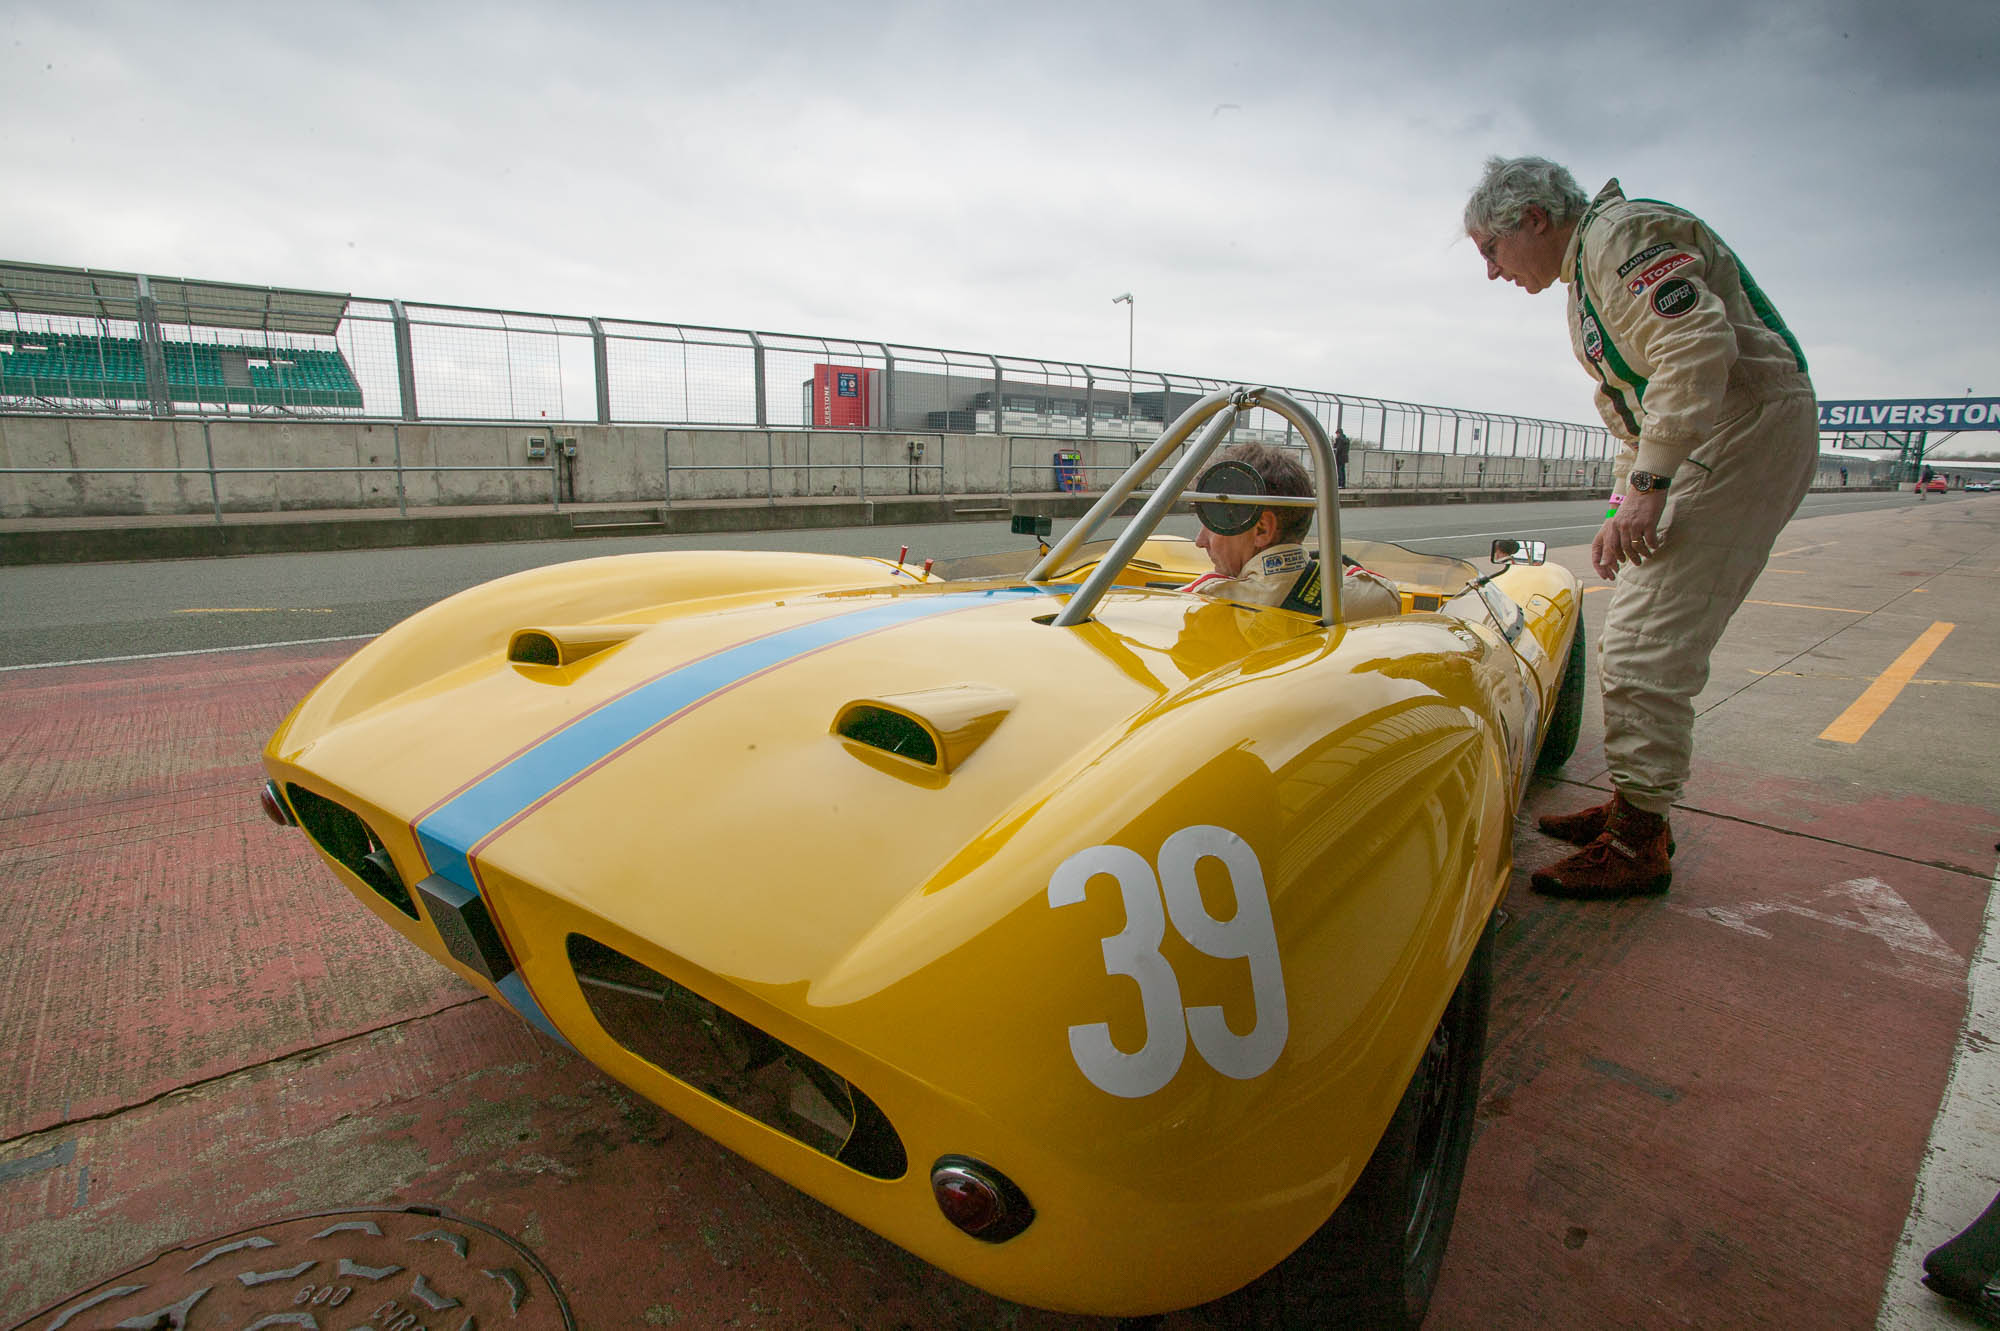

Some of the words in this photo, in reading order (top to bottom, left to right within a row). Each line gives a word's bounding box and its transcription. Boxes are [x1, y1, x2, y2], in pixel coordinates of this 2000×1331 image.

[1620, 253, 1645, 276] ALAIN
[1644, 257, 1693, 281] TOTAL
[1658, 284, 1695, 312] COOPER
[1817, 403, 2000, 425] .SILVERSTON
[1047, 824, 1289, 1098] 39
[294, 1284, 352, 1306] 600
